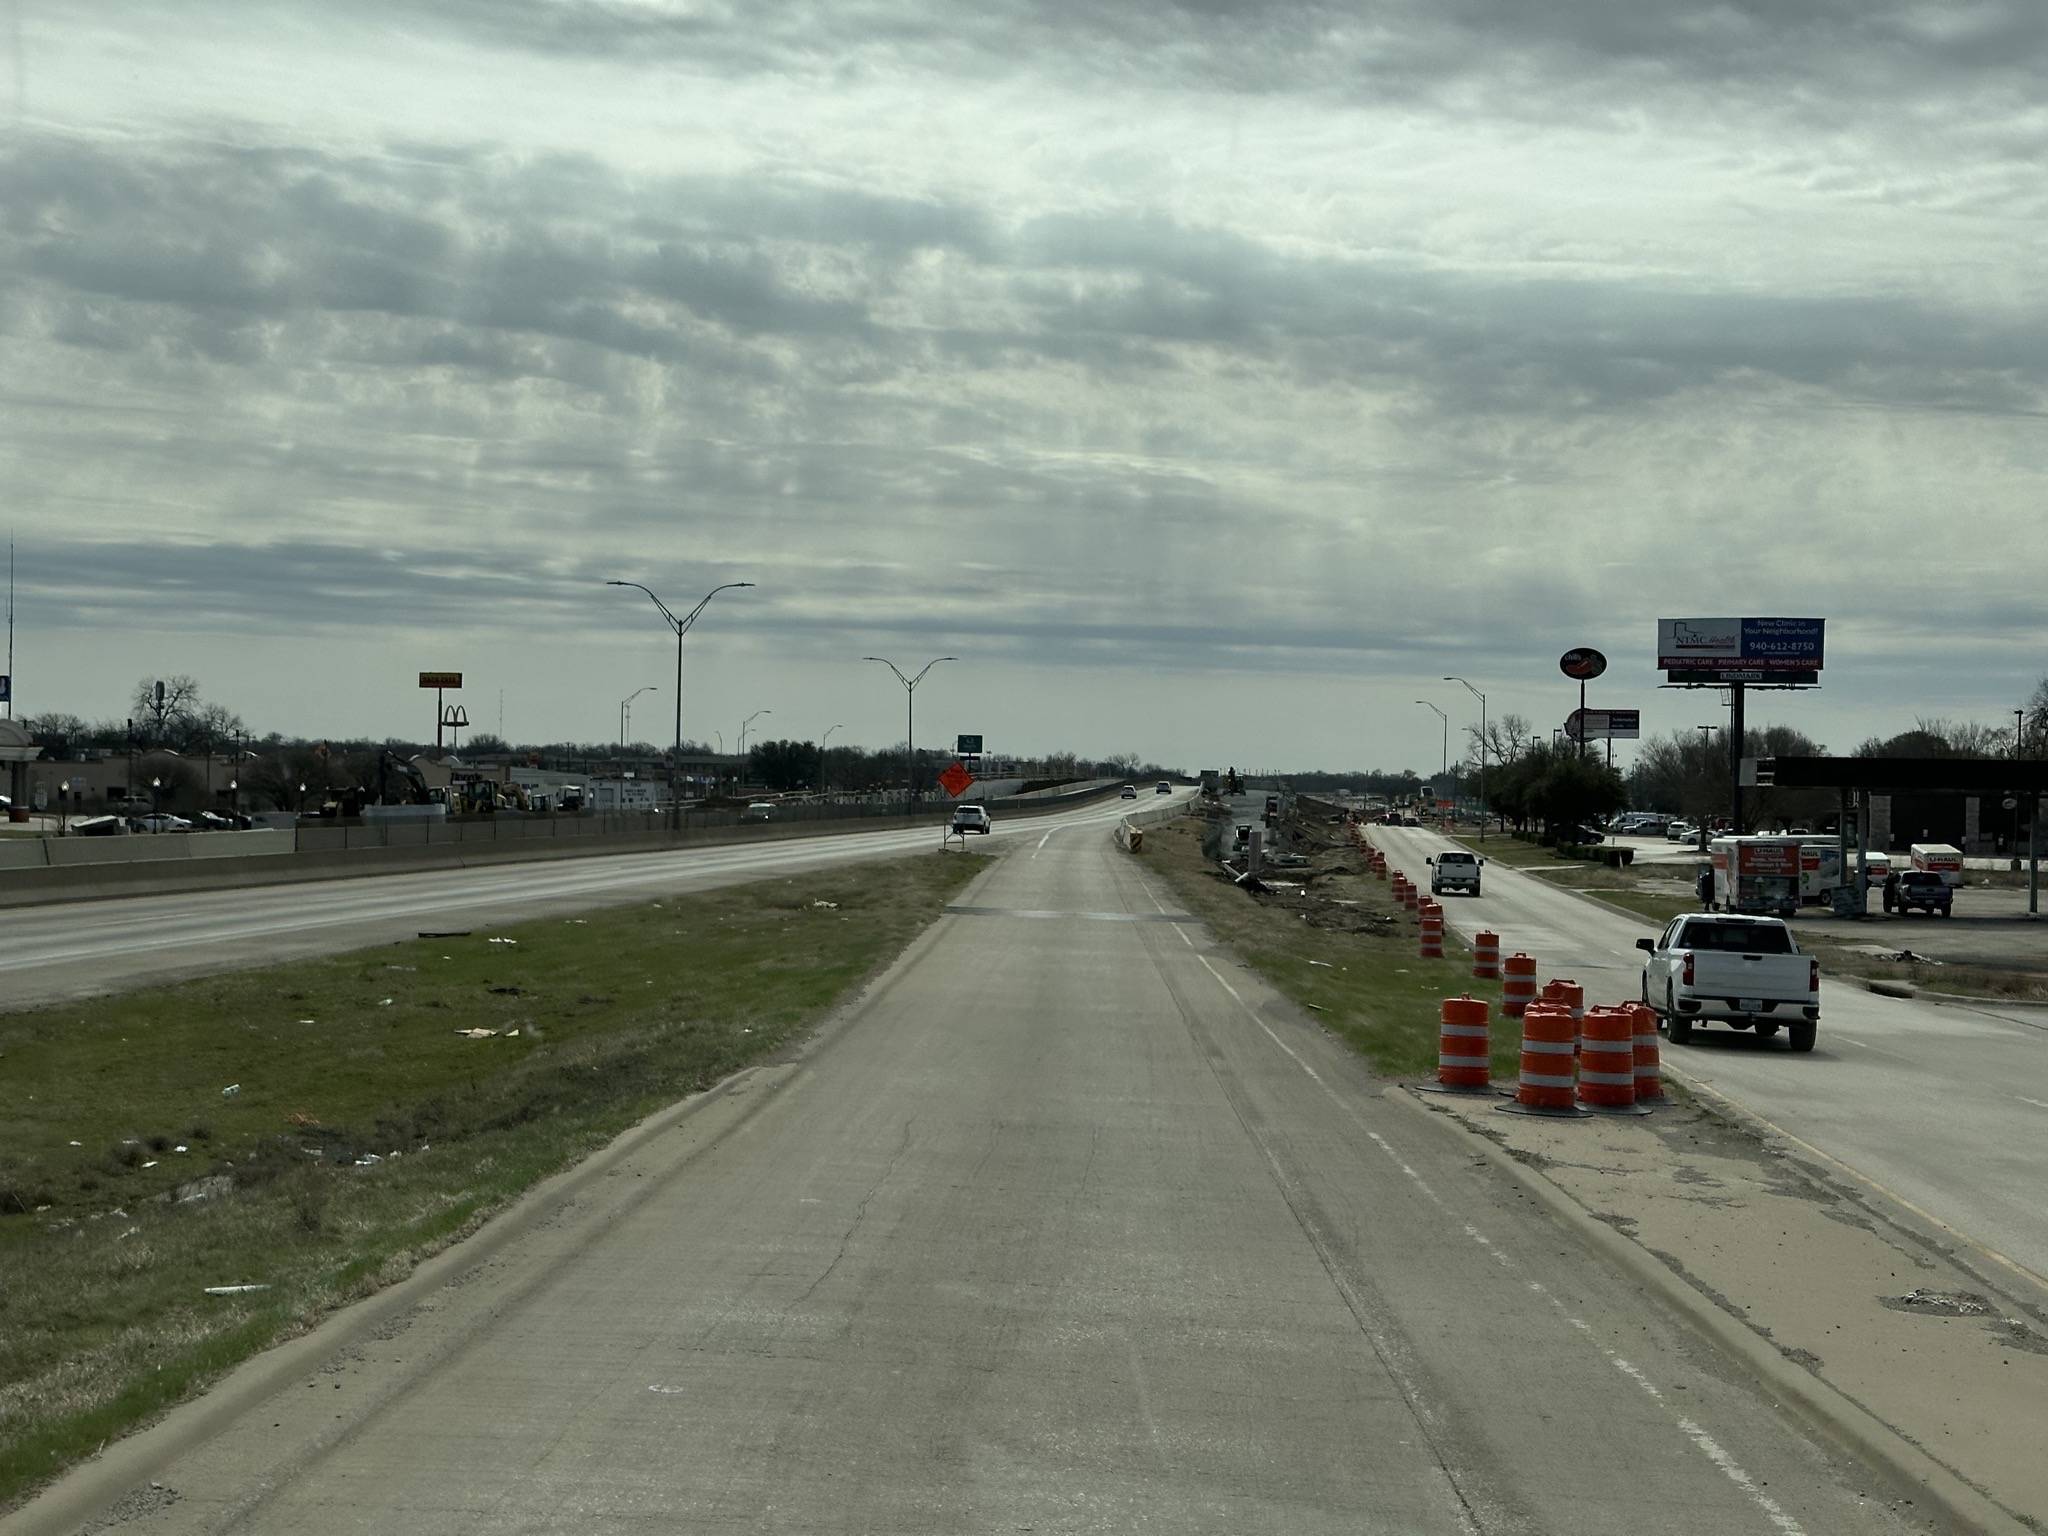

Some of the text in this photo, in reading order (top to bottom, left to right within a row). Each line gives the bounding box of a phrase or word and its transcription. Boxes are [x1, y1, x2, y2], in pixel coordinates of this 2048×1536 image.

[1776, 619, 1798, 627] Clinic
[1744, 627, 1819, 636] Your Neighborhood!
[1709, 636, 1735, 644] Health
[1749, 641, 1815, 651] 940-612-8750
